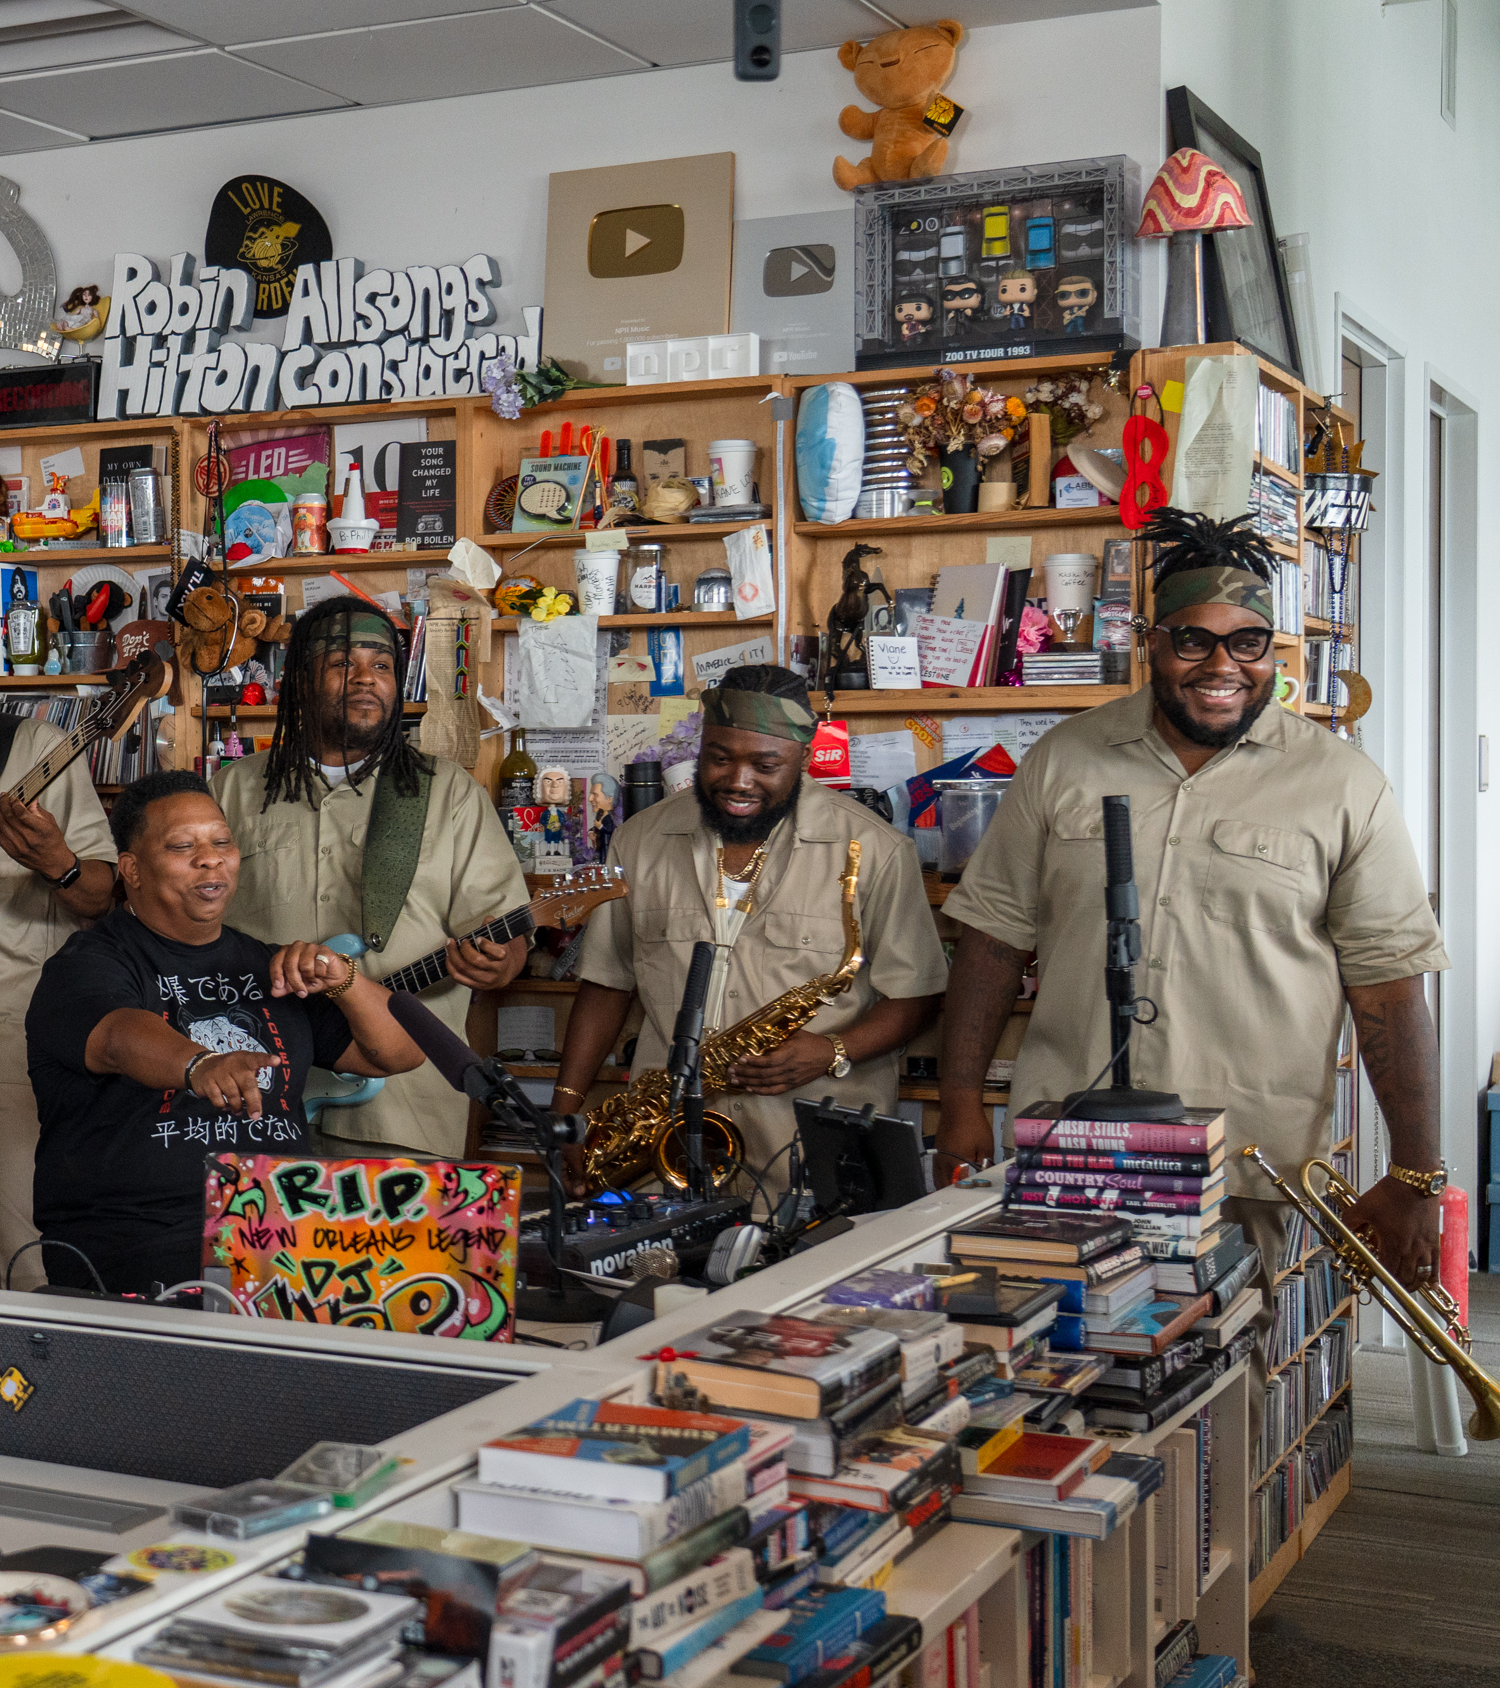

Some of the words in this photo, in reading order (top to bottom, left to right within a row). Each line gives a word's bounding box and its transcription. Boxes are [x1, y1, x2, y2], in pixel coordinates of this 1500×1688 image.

[226, 181, 286, 215] LOVE
[250, 268, 288, 282] KANSAS
[105, 252, 255, 338] Robin
[615, 327, 632, 335] NPR
[632, 325, 650, 333] Music
[787, 350, 818, 361] YouTube
[945, 351, 964, 362] ZOO
[965, 350, 978, 360] TV
[979, 347, 1005, 359] TOUR
[1007, 345, 1031, 357] 1993
[98, 333, 282, 421] Hilton
[421, 447, 444, 456] YOUR
[107, 462, 119, 471] MY
[121, 460, 142, 470] OWN
[250, 446, 288, 480] LED
[421, 458, 444, 466] SONG
[531, 464, 552, 473] SOUND
[553, 462, 582, 471] MACHINE
[412, 468, 452, 477] CHANGED
[425, 479, 438, 487] MY
[422, 488, 441, 497] LIFE
[715, 484, 741, 499] KANE
[101, 504, 124, 512] BLUE
[101, 512, 124, 520] MAN
[424, 536, 454, 544] BOILEN
[122, 629, 150, 647] Don't
[1019, 719, 1032, 727] They
[813, 748, 843, 762] SiR
[151, 1114, 302, 1149] 平均的でない
[1051, 1120, 1093, 1137] CROSBY,
[1094, 1122, 1133, 1139] STILLS,
[1058, 1137, 1087, 1150] NASH
[1091, 1137, 1126, 1151] YOUNG
[1122, 1158, 1182, 1171] metallica
[1035, 1171, 1106, 1187] COUNTRY
[1104, 1173, 1143, 1190] Soul
[1022, 1192, 1044, 1202] JUST
[1047, 1192, 1056, 1202] A
[1059, 1194, 1086, 1204] SHOT
[1090, 1196, 1123, 1207] AWAY
[1143, 1201, 1177, 1209] AUSTERLITZ
[238, 1225, 297, 1251] NEW
[313, 1228, 415, 1255] ORLEANS
[427, 1226, 506, 1263] LEGEND
[1152, 1241, 1170, 1256] WAY
[590, 1237, 674, 1278] novation
